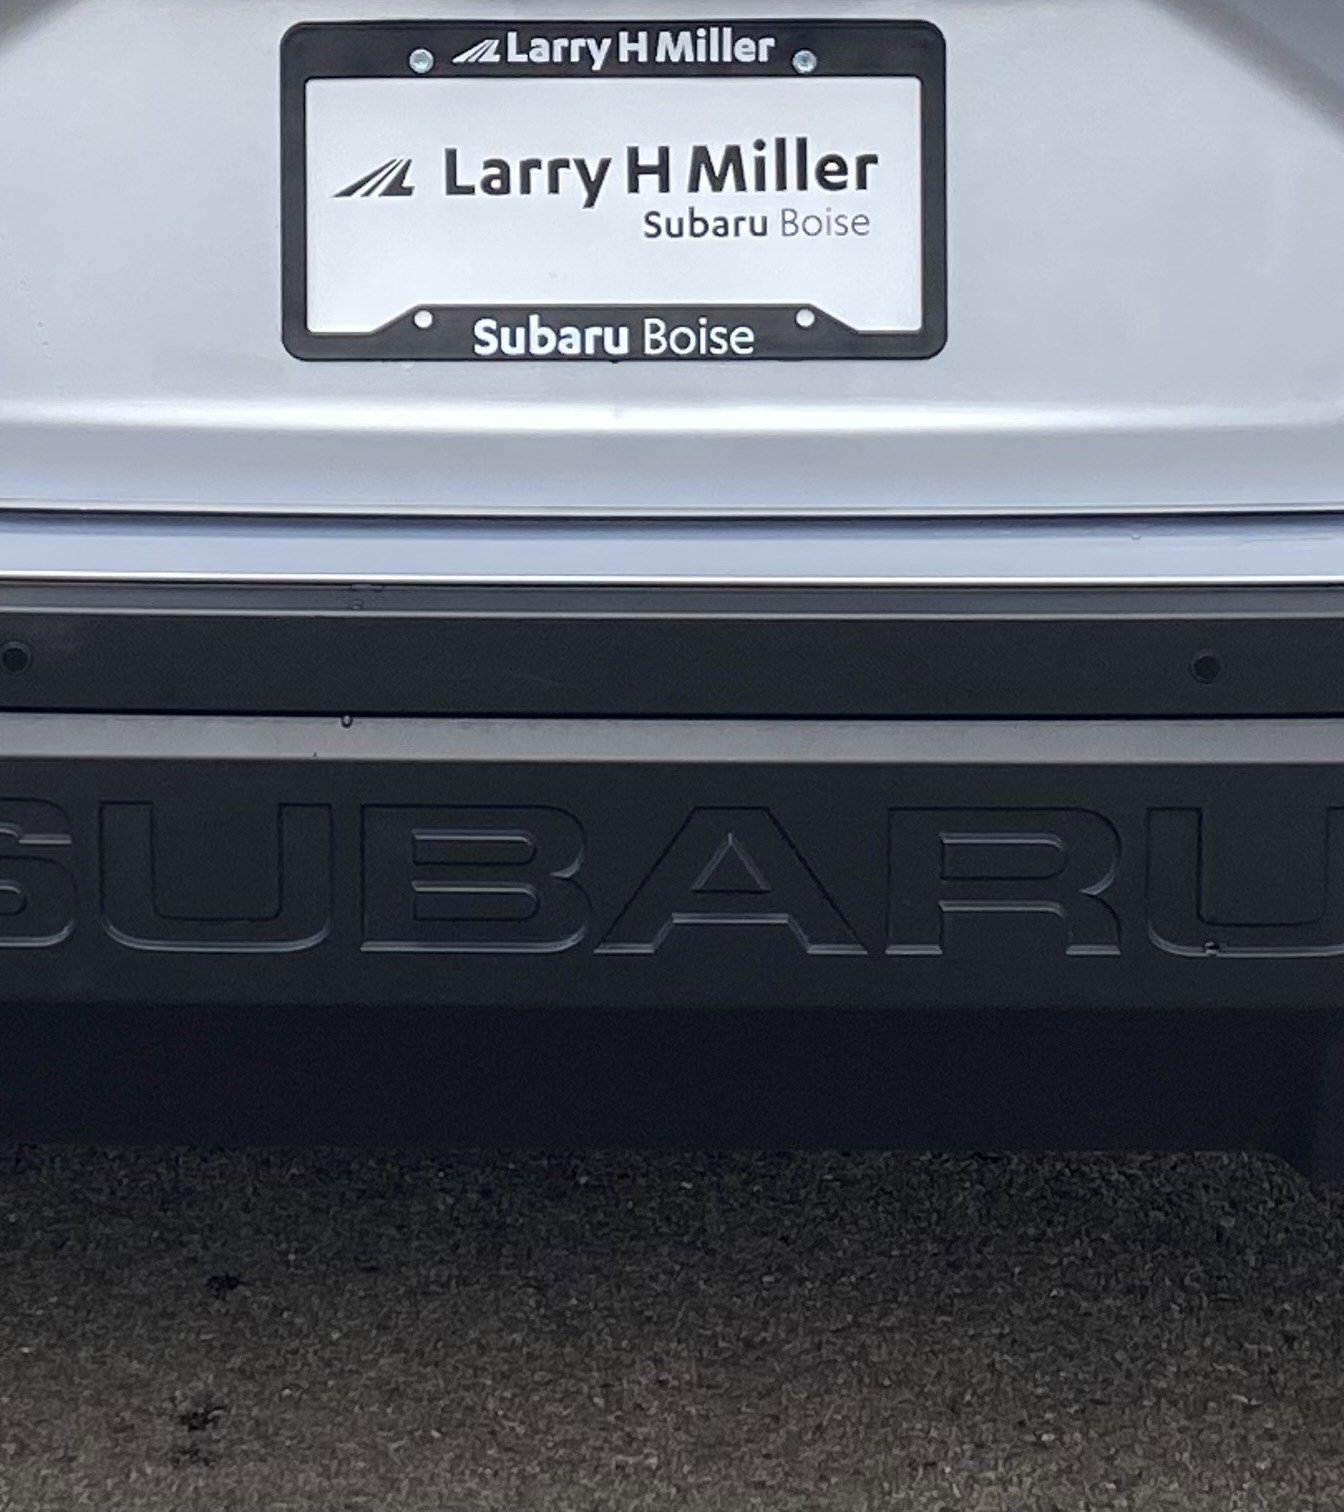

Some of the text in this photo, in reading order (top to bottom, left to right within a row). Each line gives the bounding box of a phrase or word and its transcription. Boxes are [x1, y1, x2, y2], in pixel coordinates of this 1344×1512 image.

[506, 27, 775, 71] Larry H Miller
[444, 136, 880, 209] Larry H Miller
[643, 207, 871, 239] Subaru Boise
[473, 314, 756, 356] Subaru Boise
